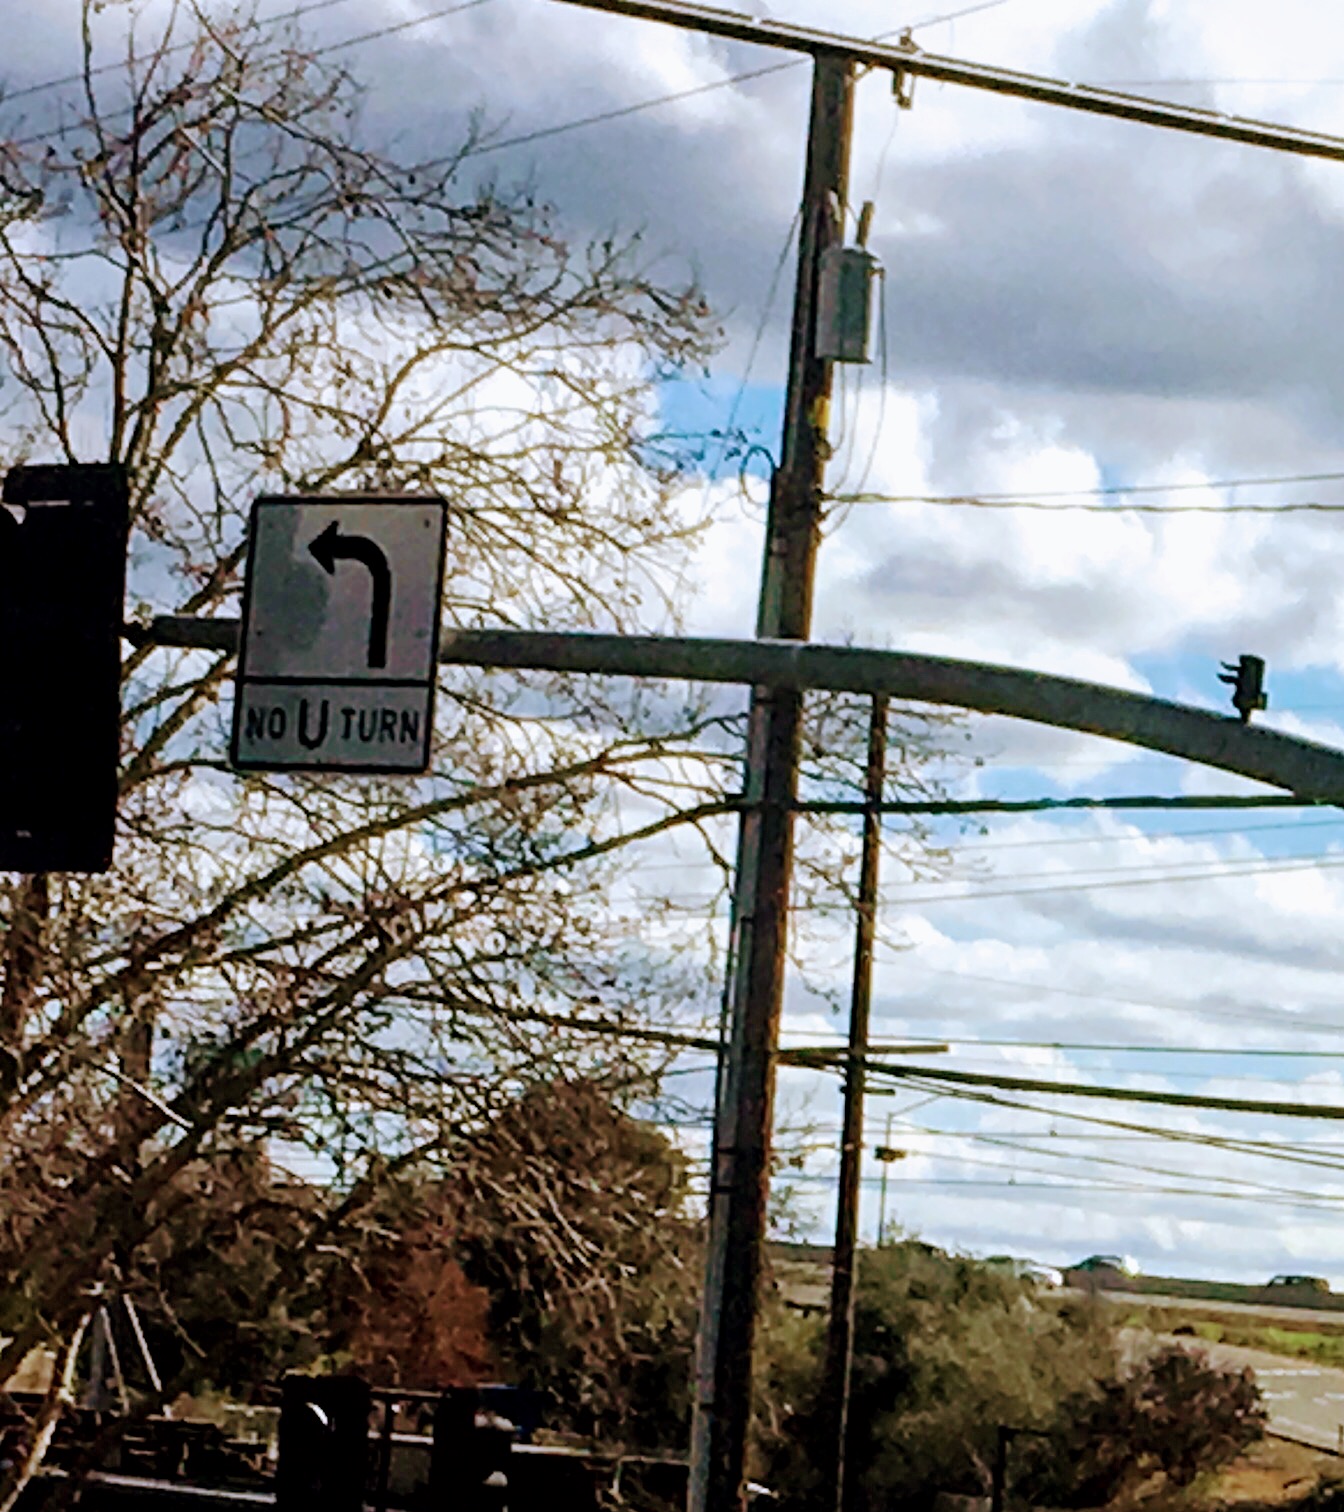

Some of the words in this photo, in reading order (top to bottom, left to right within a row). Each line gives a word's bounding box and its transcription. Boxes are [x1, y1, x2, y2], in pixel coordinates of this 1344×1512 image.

[246, 707, 287, 743] NO
[296, 699, 329, 750] U
[338, 707, 420, 747] TURN
